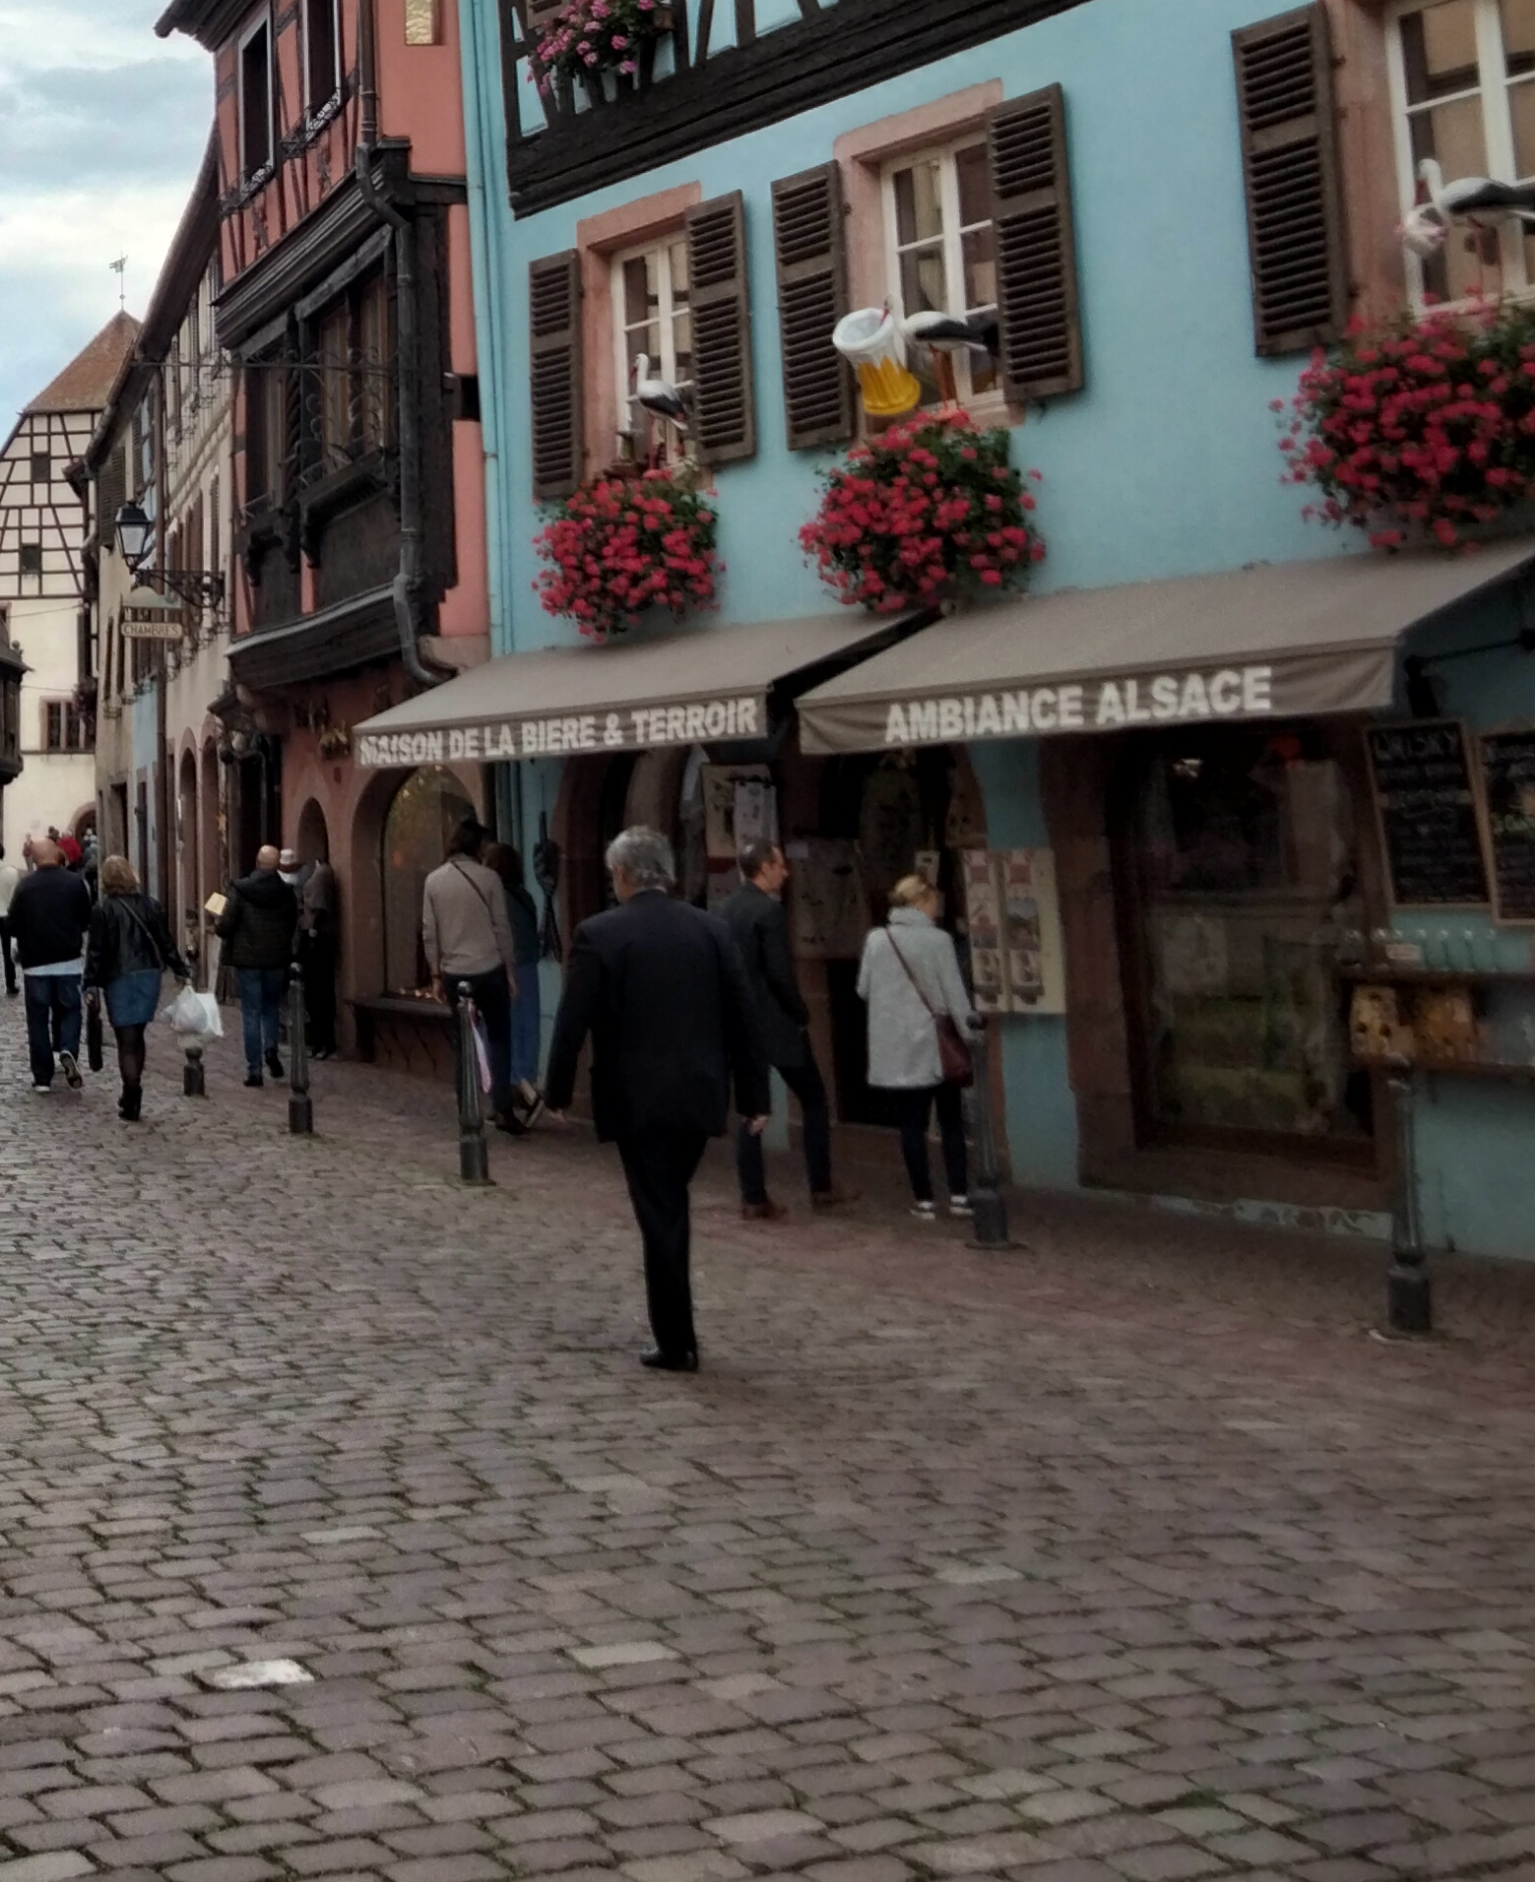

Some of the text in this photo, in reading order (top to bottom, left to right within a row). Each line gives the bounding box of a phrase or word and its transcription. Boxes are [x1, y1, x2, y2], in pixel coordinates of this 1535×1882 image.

[124, 623, 179, 636] CHAMBRES
[360, 698, 757, 766] MAISON DE LA BIERE & TERROIR
[884, 666, 1273, 743] AMBIANCE ALSACE
